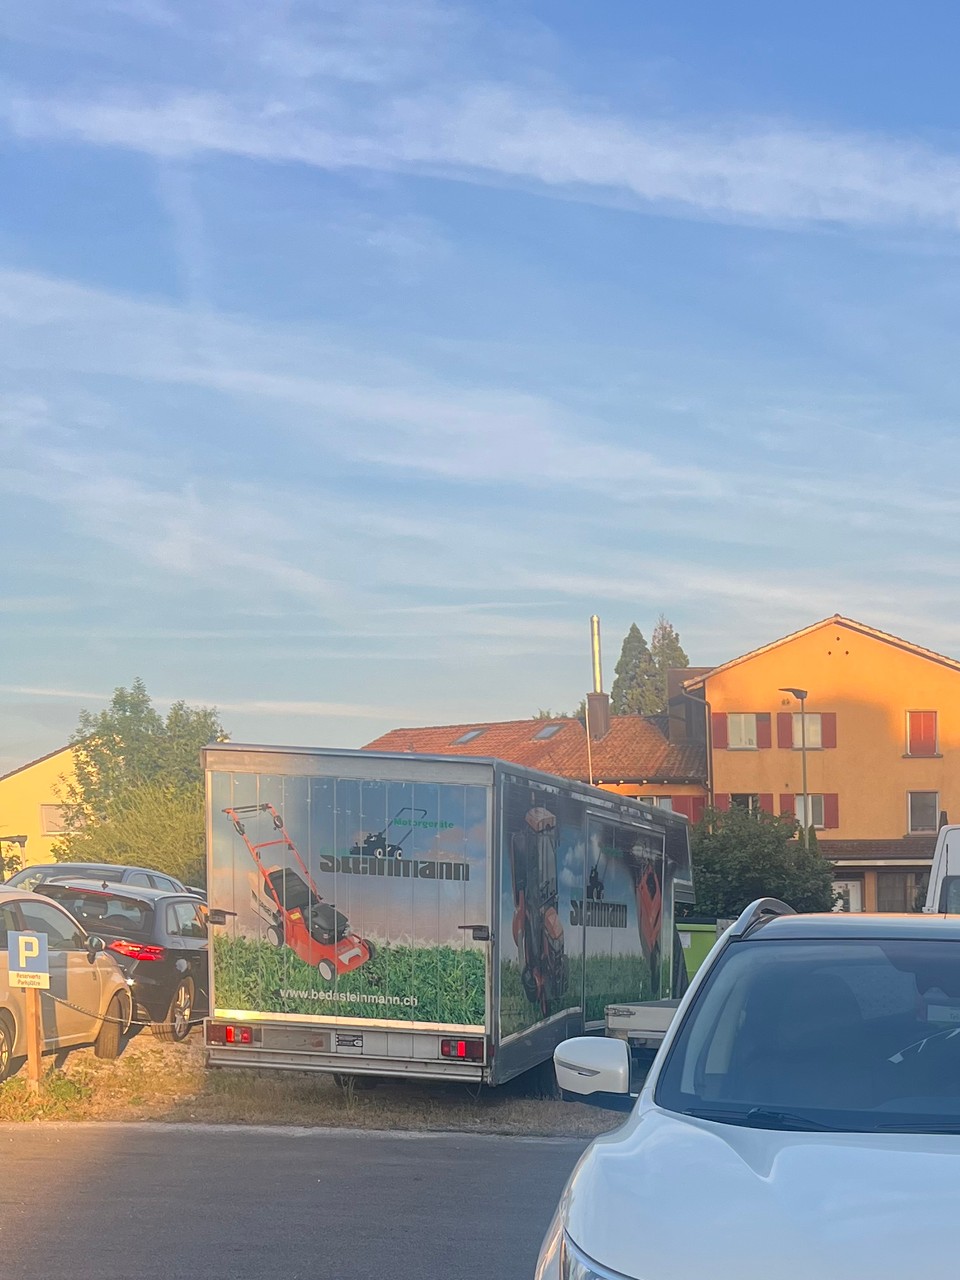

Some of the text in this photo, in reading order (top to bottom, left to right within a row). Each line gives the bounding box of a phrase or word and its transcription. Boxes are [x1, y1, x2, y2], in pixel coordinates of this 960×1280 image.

[319, 854, 470, 881] Steinmann
[18, 935, 39, 968] P
[280, 989, 418, 1006] www.bedasteinmann.ch
